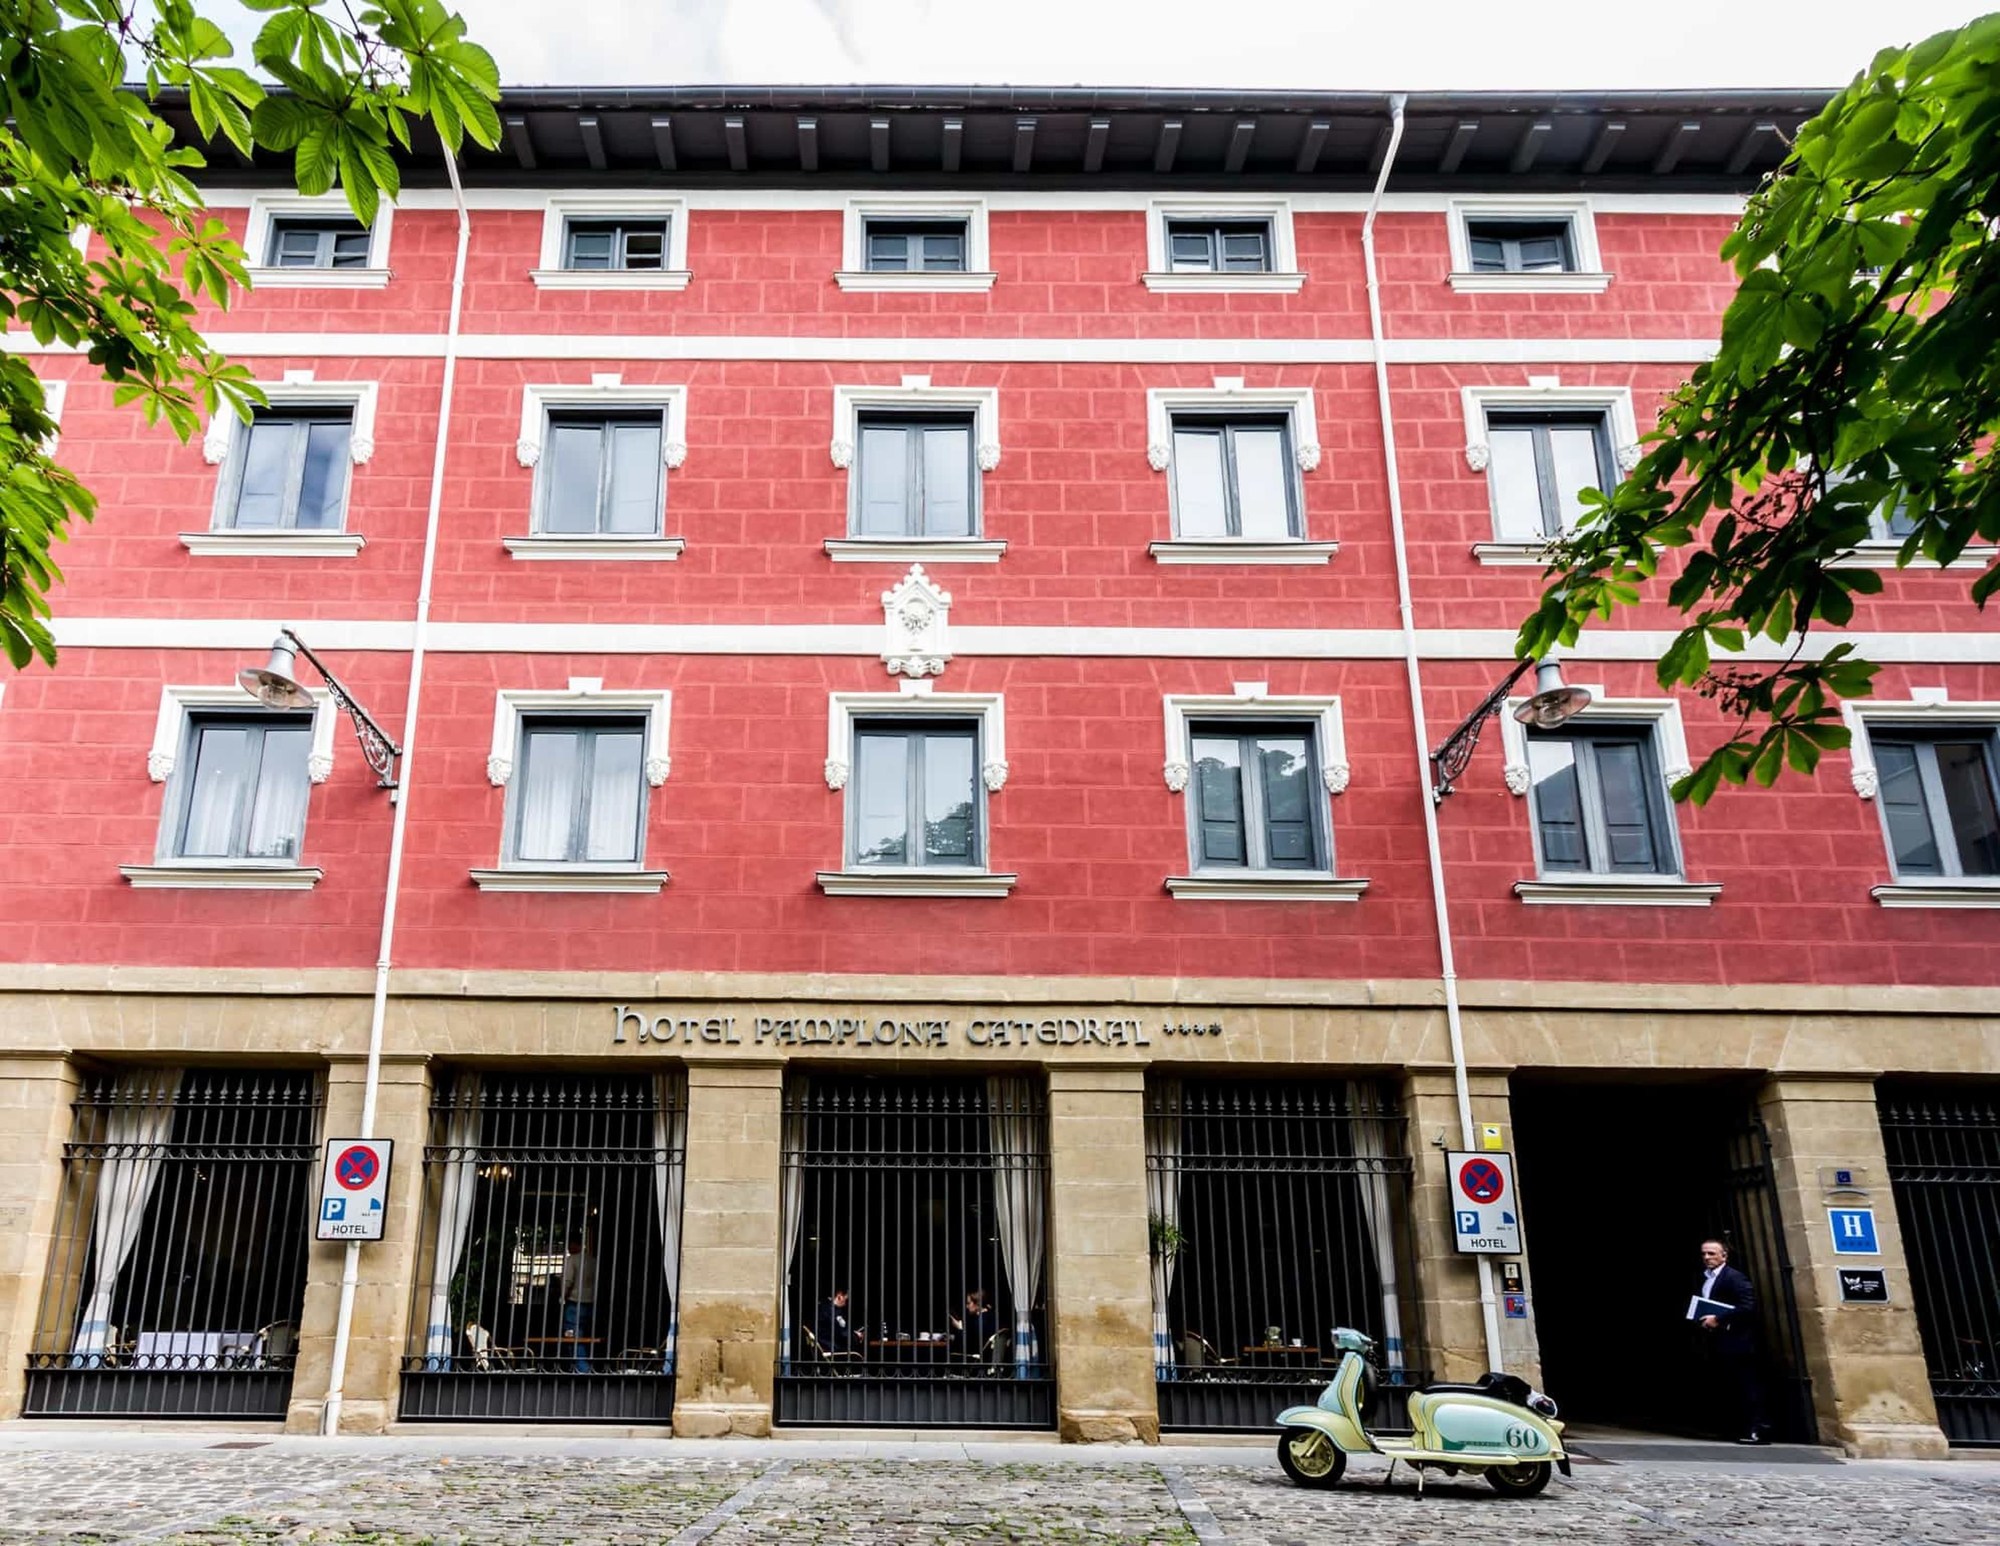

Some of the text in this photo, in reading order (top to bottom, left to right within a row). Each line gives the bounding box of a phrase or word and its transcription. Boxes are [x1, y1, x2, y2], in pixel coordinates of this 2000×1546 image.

[755, 1017, 951, 1047] PAMPLONA
[965, 1019, 1151, 1047] CATEDRAL
[326, 1199, 342, 1219] P
[331, 1224, 368, 1235] HOTEL
[1460, 1213, 1476, 1233] P
[1841, 1214, 1865, 1238] H
[1470, 1238, 1507, 1249] HOTEL
[1505, 1427, 1540, 1450] 60
